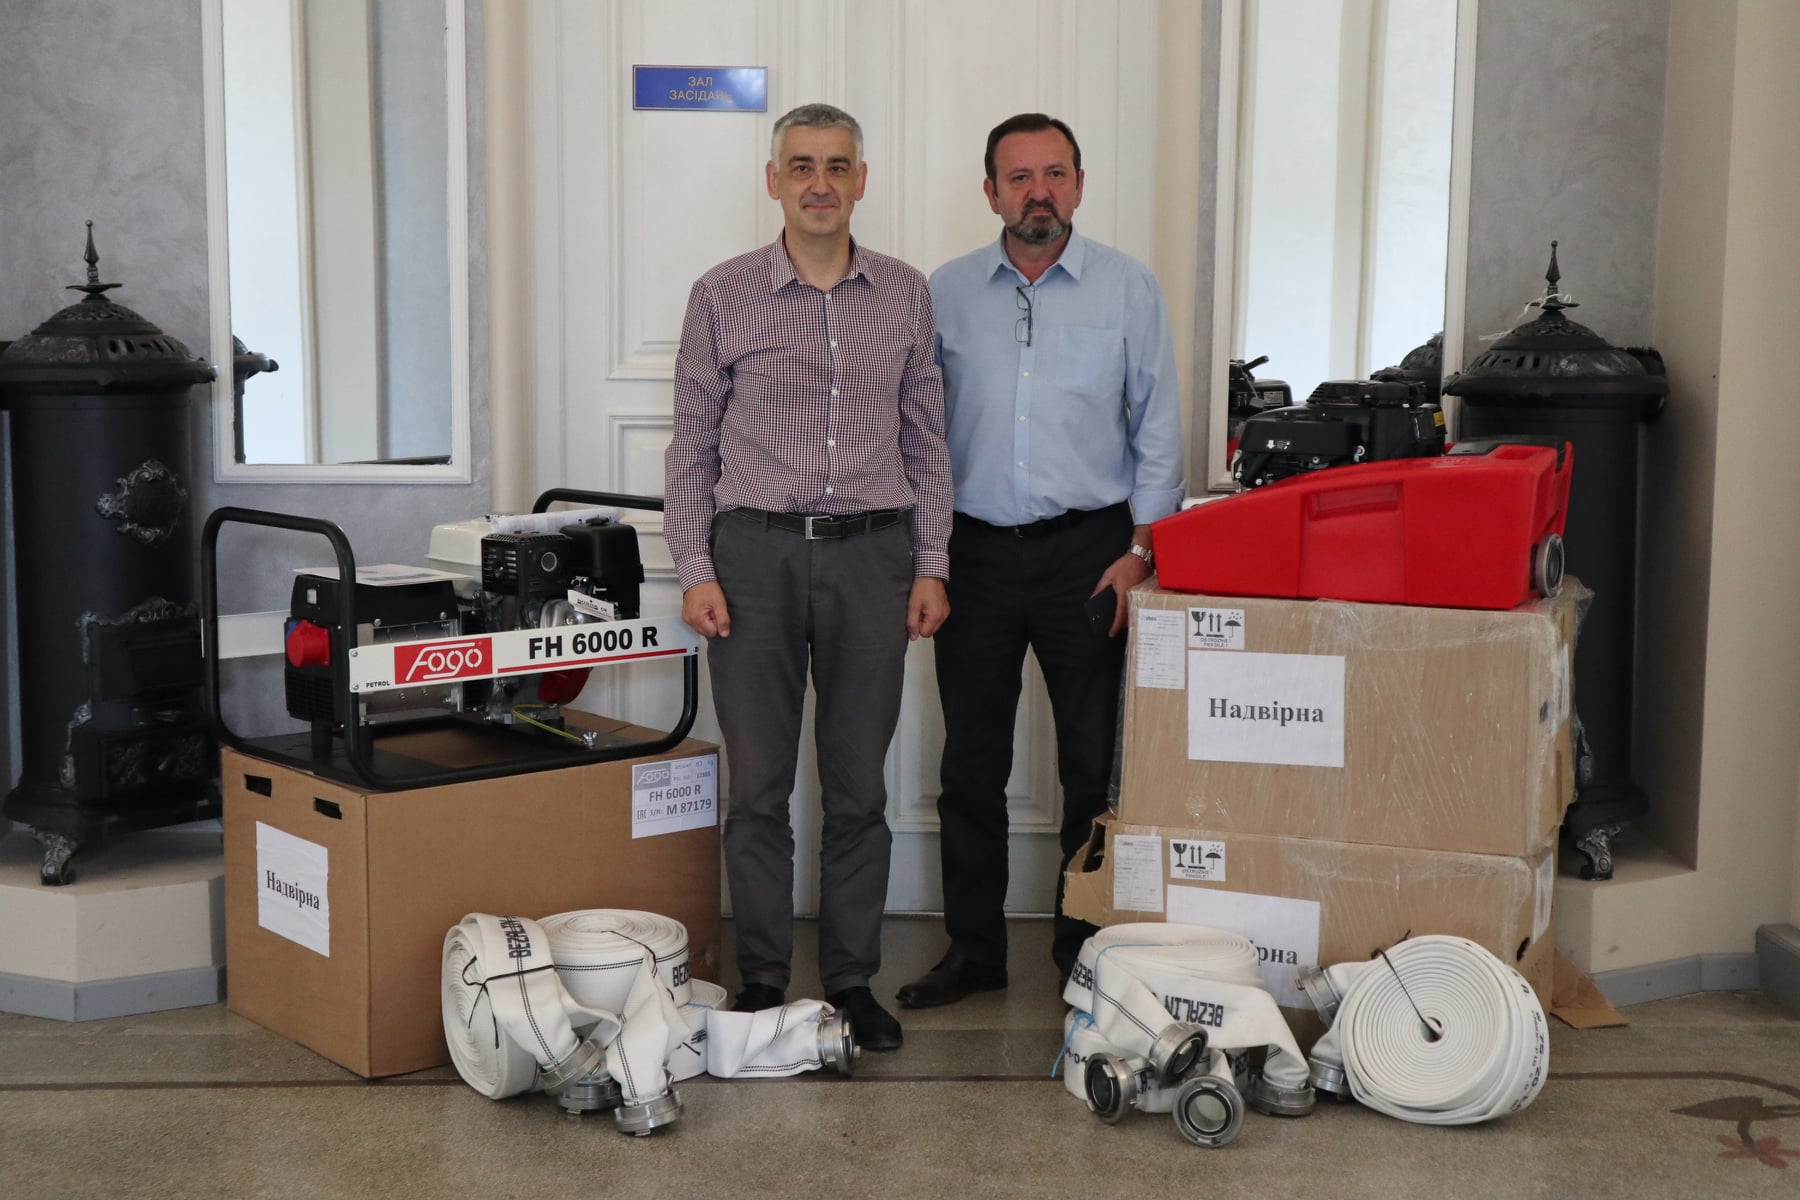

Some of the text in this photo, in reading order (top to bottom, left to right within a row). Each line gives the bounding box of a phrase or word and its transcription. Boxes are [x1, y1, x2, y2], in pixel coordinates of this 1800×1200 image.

[688, 76, 713, 87] ЗАЛ
[529, 626, 659, 660] FH 6000 R
[365, 680, 391, 688] PETROL
[1208, 697, 1325, 727] Надвірна
[649, 784, 701, 803] FH 6000 R
[667, 803, 677, 816] M
[680, 798, 712, 814] 87179
[266, 869, 320, 911] Надвірна
[1164, 995, 1224, 1028] BEZALIN
